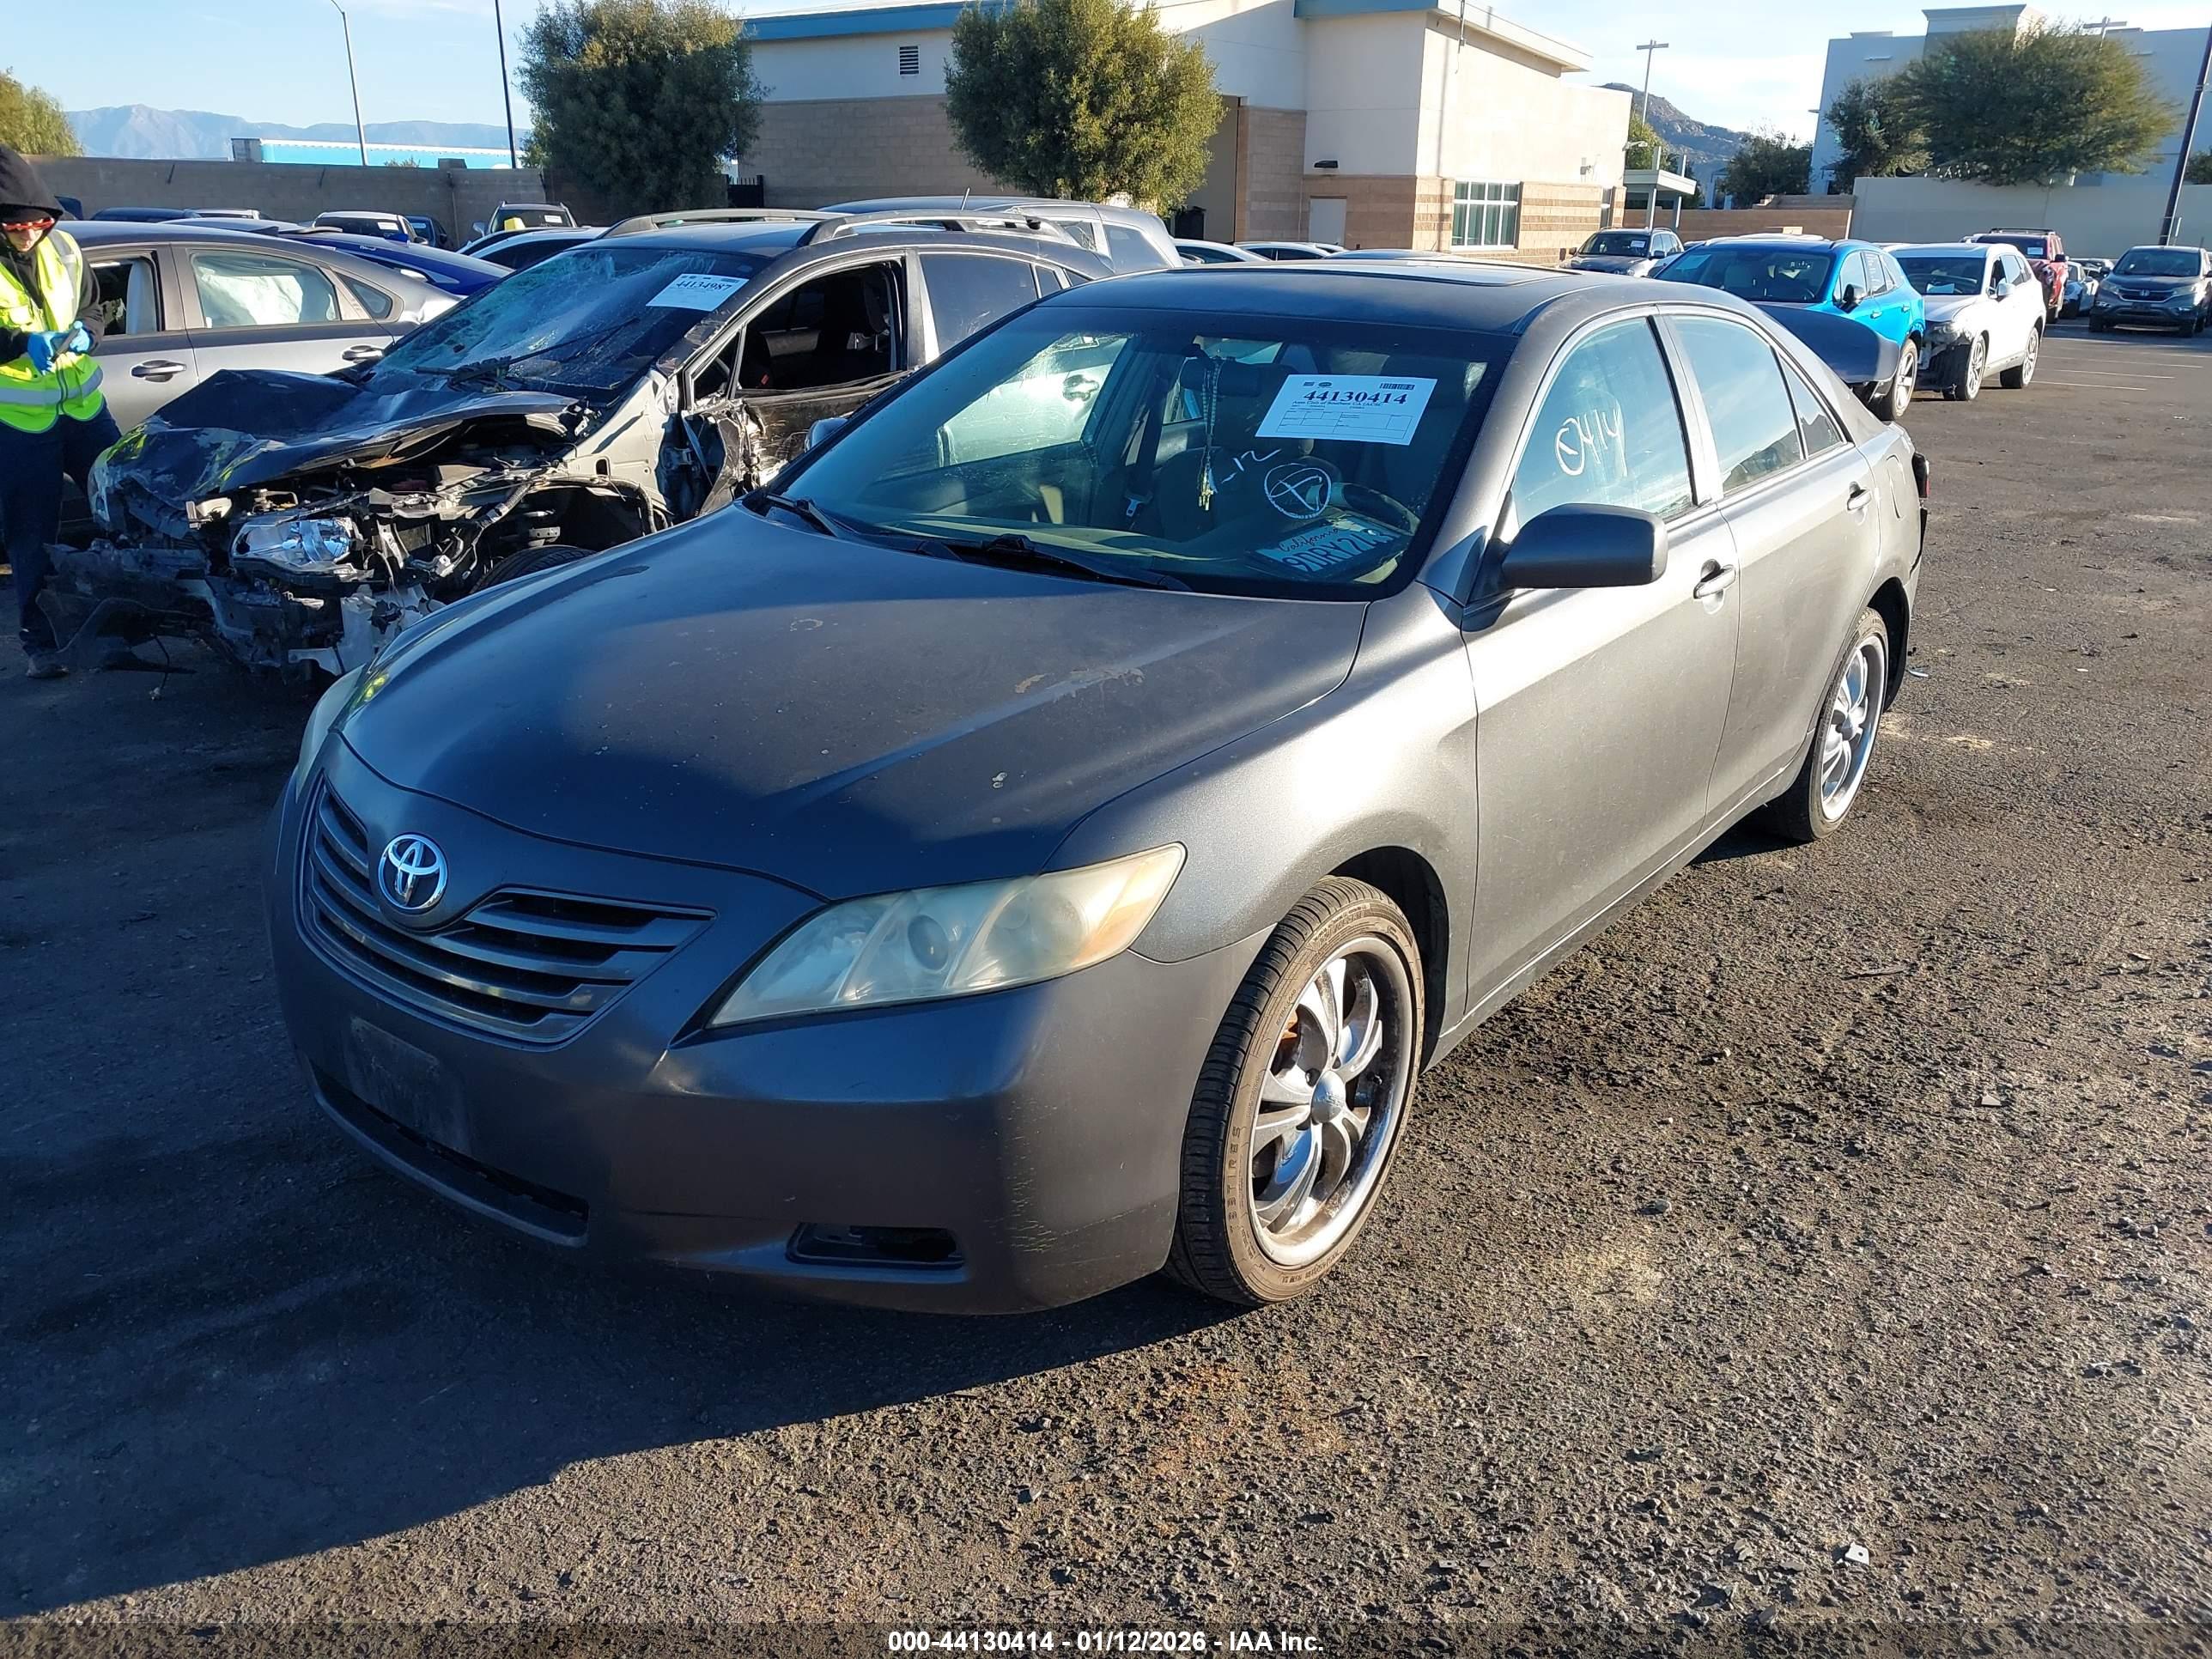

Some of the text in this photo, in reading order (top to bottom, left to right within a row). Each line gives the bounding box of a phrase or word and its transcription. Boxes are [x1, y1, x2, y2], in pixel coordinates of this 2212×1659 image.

[1304, 390, 1407, 404] 44130414
[1555, 408, 1628, 477] 0414
[1279, 527, 1339, 552] California
